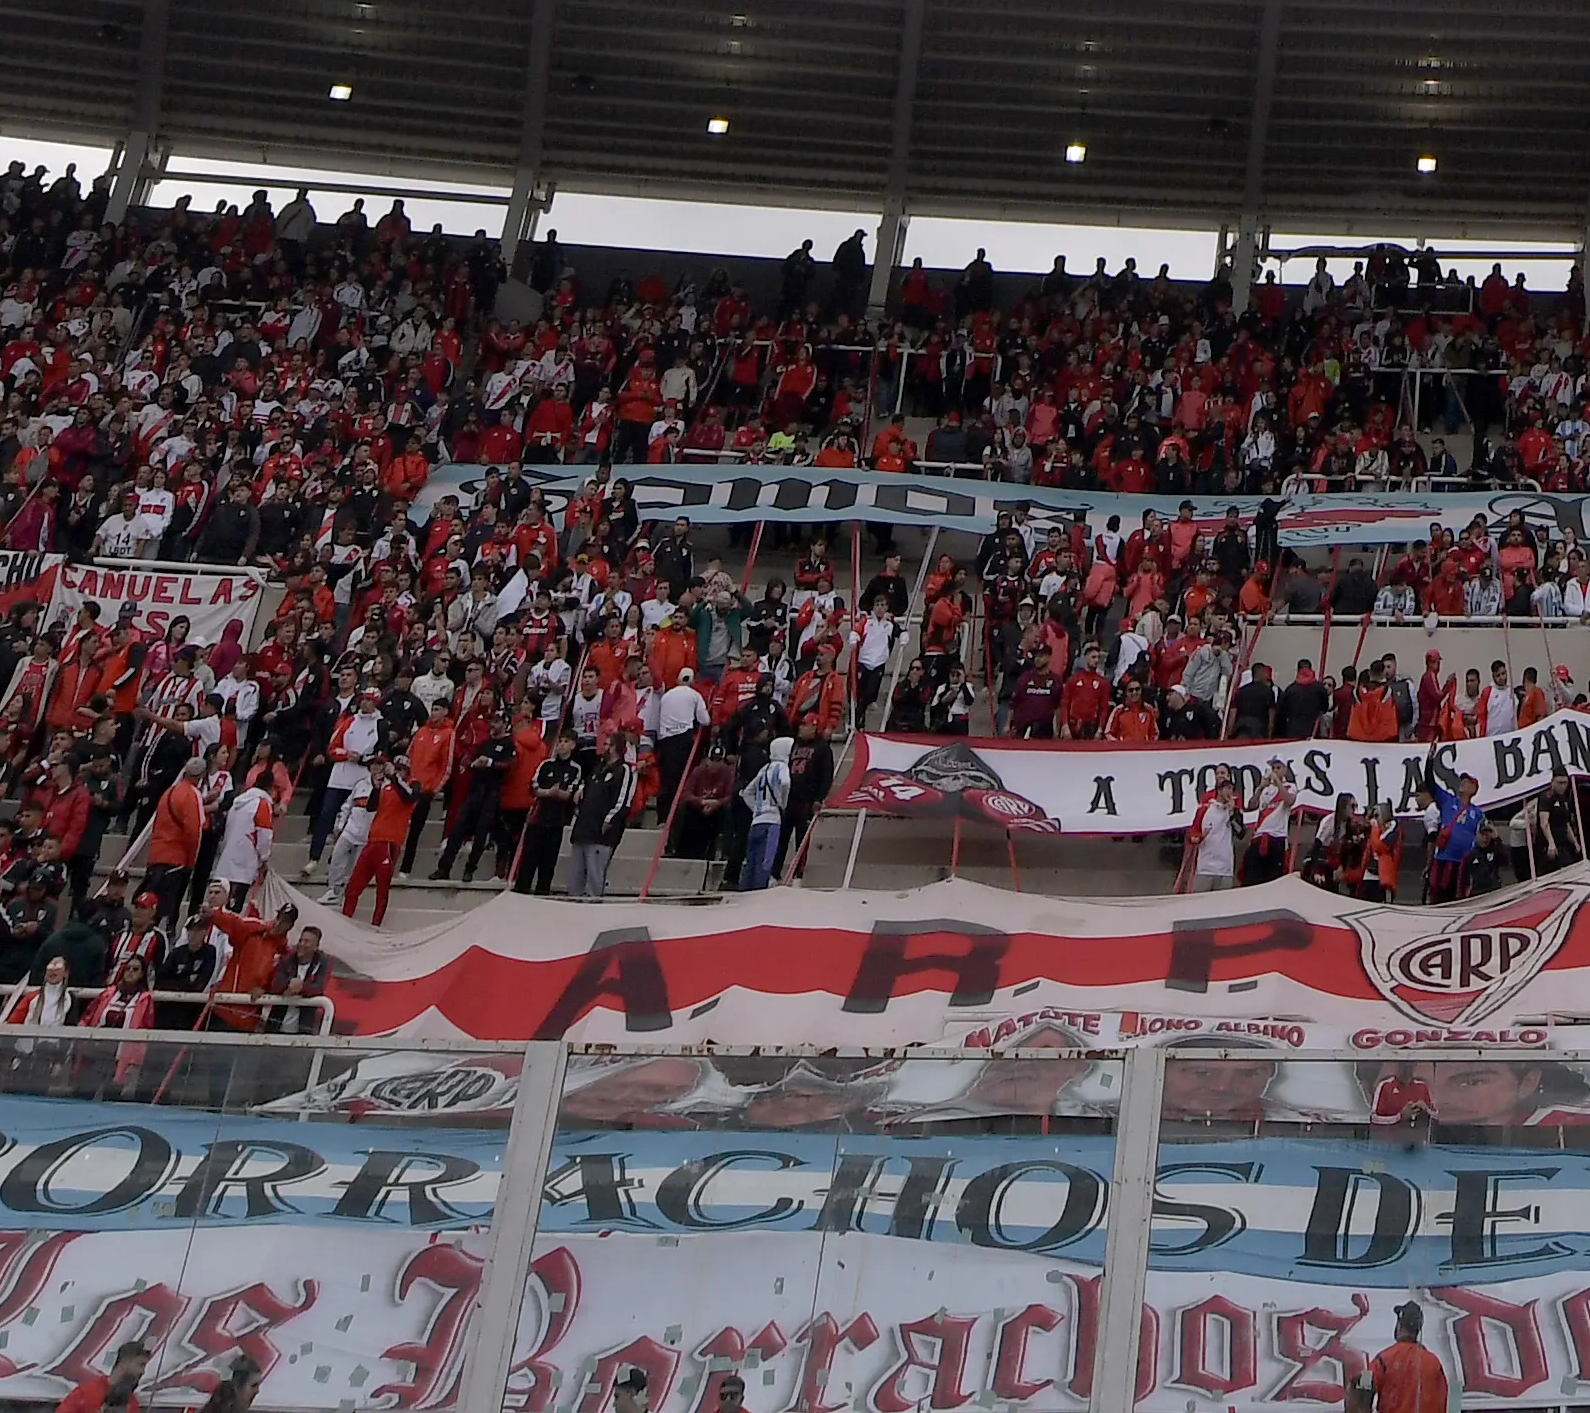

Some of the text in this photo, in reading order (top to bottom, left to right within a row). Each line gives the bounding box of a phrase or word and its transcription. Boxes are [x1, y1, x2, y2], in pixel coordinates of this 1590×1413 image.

[115, 533, 130, 545] 14
[1086, 775, 1119, 816] A
[1156, 749, 1335, 815] TODS
[963, 1006, 1102, 1049] MATUTE
[1215, 1019, 1305, 1048] ALBINO
[1351, 1028, 1548, 1050] GONZALO
